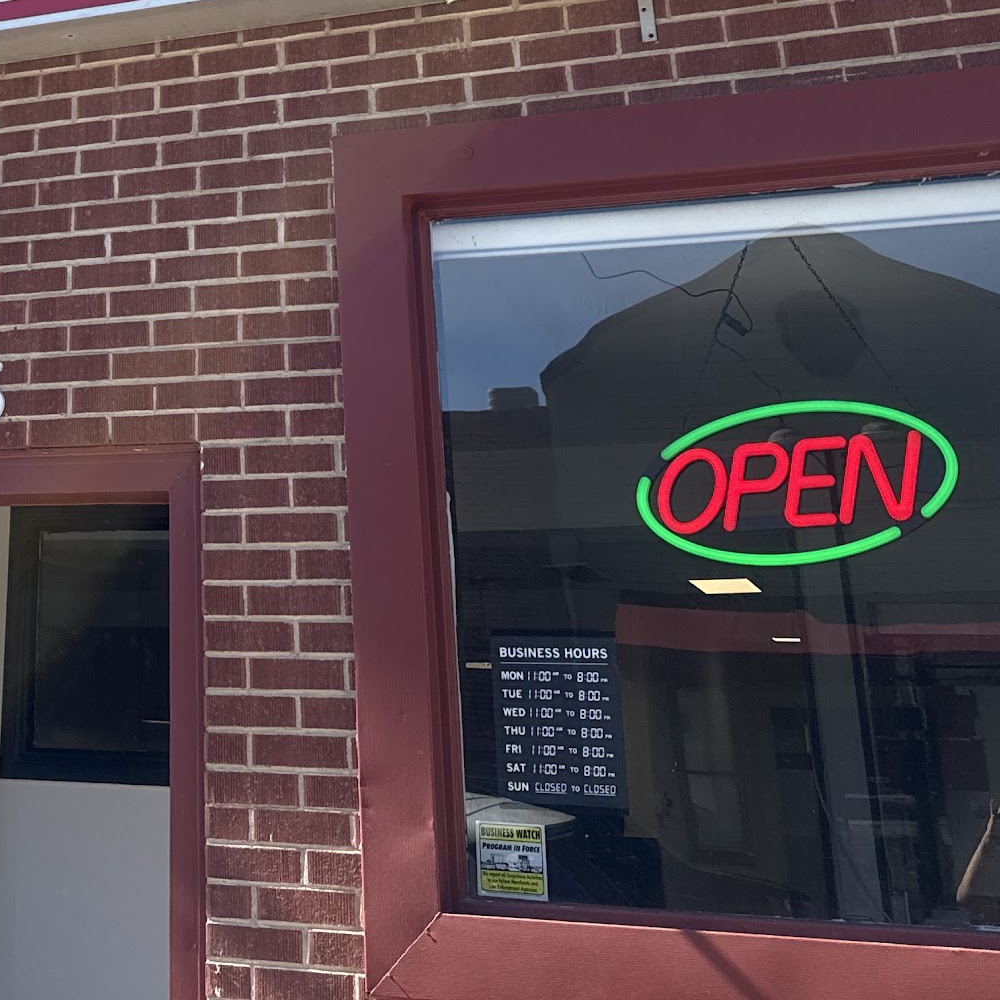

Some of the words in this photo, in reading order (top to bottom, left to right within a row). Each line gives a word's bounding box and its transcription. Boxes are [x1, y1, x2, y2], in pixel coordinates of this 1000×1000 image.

[657, 430, 922, 535] OPEN
[499, 647, 560, 658] BUSINESS
[564, 648, 608, 659] HOURS
[501, 671, 524, 680] MON
[528, 671, 551, 681] 11:00
[576, 671, 599, 682] 8:00
[502, 689, 523, 698] TUE
[528, 689, 552, 700] 11:00
[578, 690, 600, 701] 8:00
[502, 707, 526, 717] WED
[529, 707, 553, 718] 11:00
[579, 708, 602, 720] 8:00
[504, 725, 525, 735] THU
[530, 726, 555, 737] 11:00
[581, 727, 603, 739] 8:00
[505, 744, 522, 754] FRI
[532, 744, 556, 756] 11:00
[582, 746, 605, 758] 8:00
[506, 763, 526, 772] SAT
[533, 763, 557, 775] 11:00
[583, 765, 606, 777] 8:00
[507, 781, 529, 791] SUN
[535, 782, 567, 792] CLOSED
[583, 784, 616, 795] CLOSED
[480, 826, 514, 838] BUSINESS
[515, 829, 540, 840] WATCH
[482, 842, 512, 850] PROGRAM
[522, 845, 540, 853] FORCE
